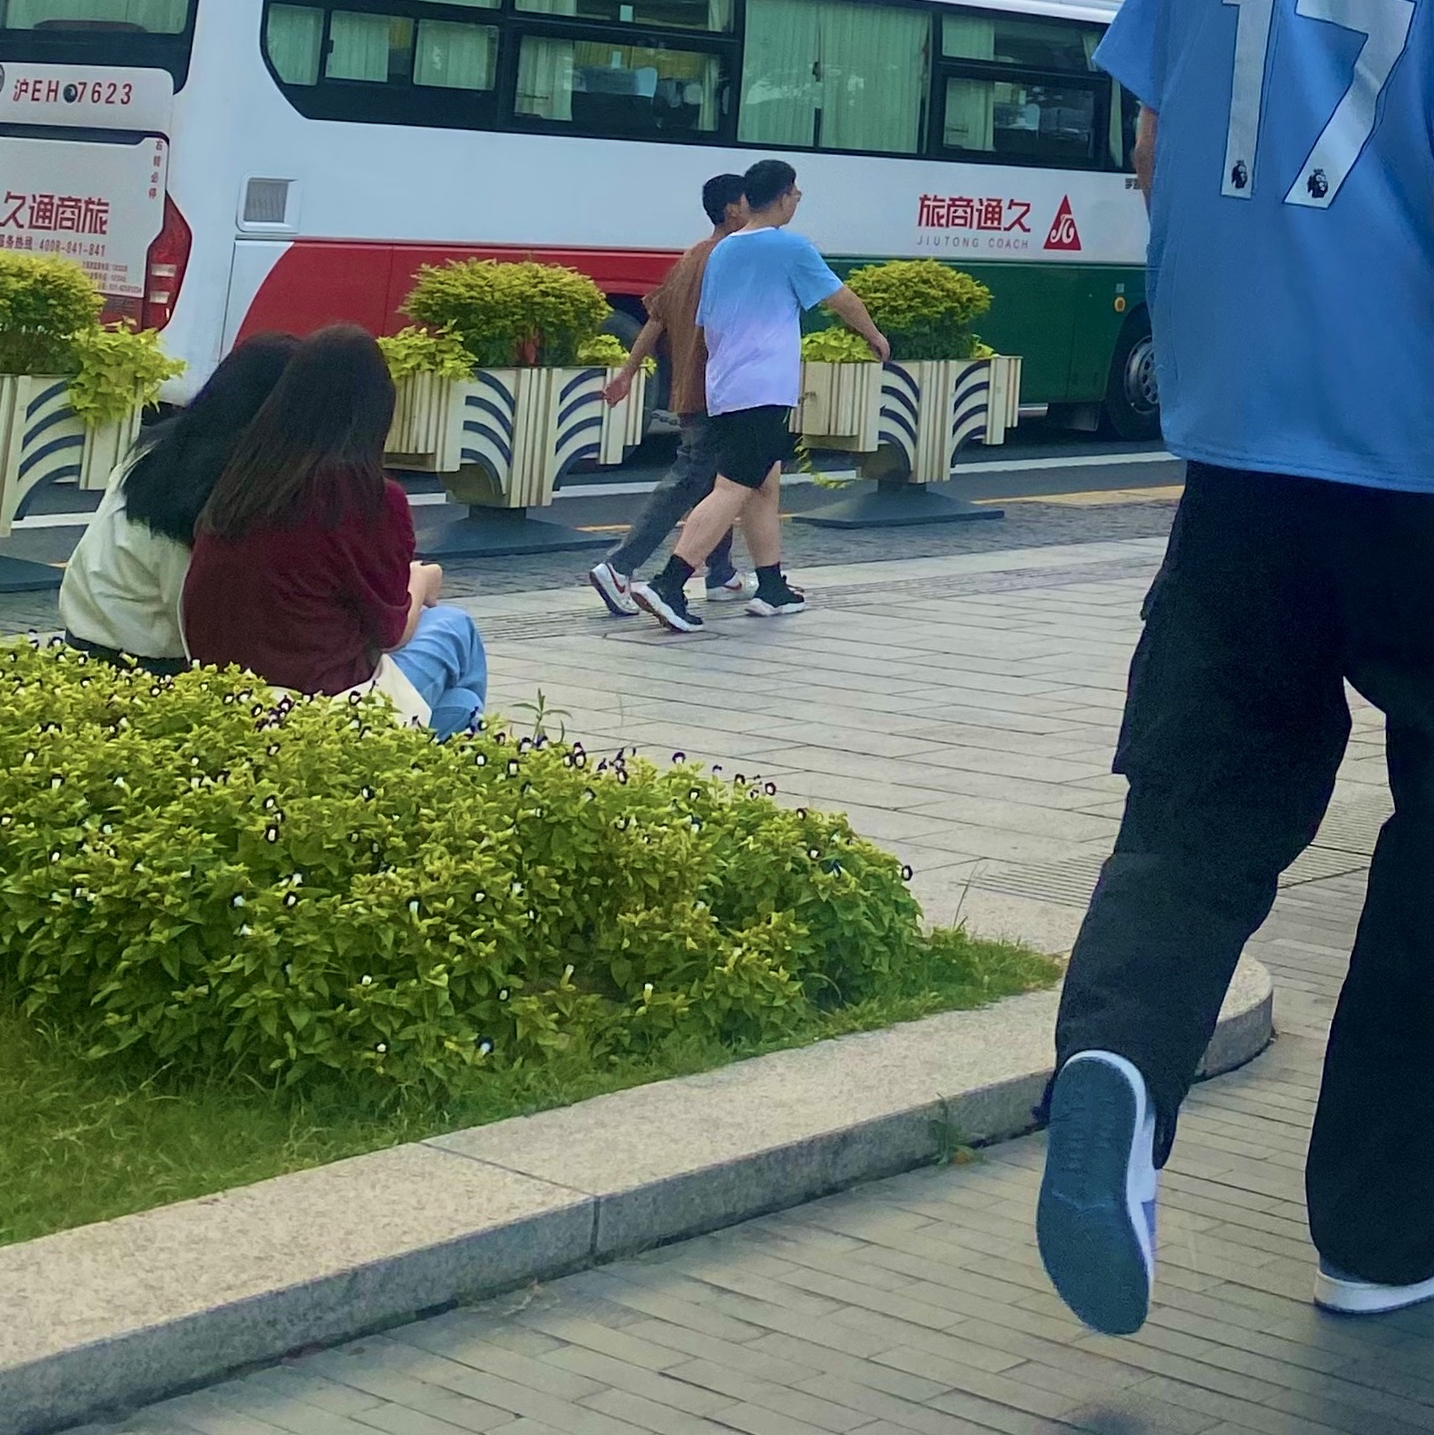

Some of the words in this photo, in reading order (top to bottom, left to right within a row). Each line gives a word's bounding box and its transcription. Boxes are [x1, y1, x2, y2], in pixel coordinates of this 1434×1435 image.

[0, 190, 110, 235] 久通商旅
[916, 235, 980, 249] JIUTONG
[988, 237, 1029, 250] COACH
